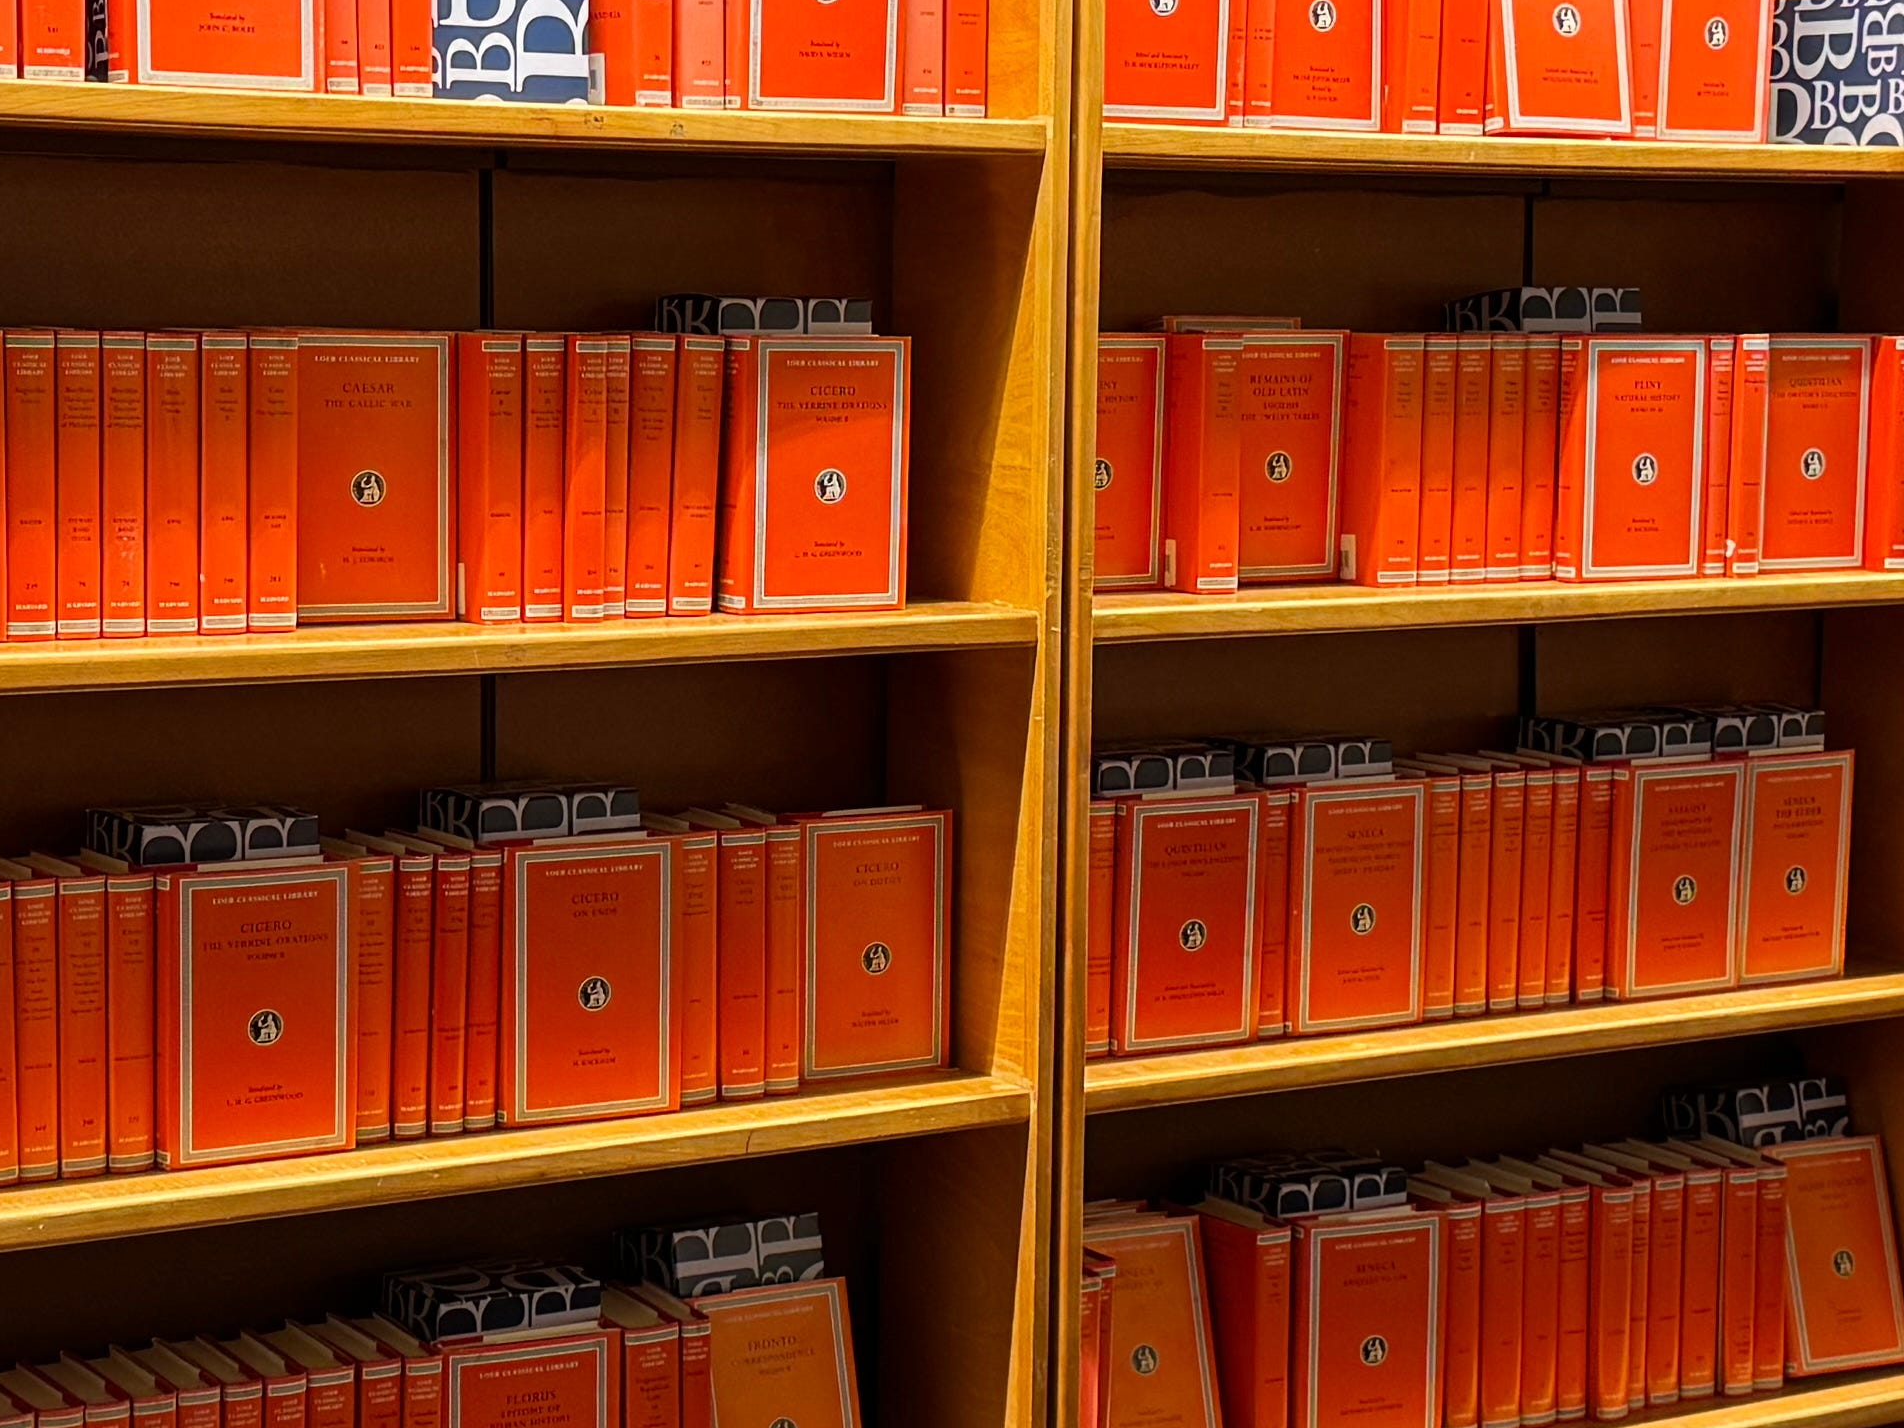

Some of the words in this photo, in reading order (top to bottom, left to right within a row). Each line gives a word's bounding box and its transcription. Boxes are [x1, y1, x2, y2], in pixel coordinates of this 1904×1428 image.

[342, 382, 394, 394] CAESAR
[571, 892, 619, 905] CICERO
[240, 920, 291, 934] CICERO
